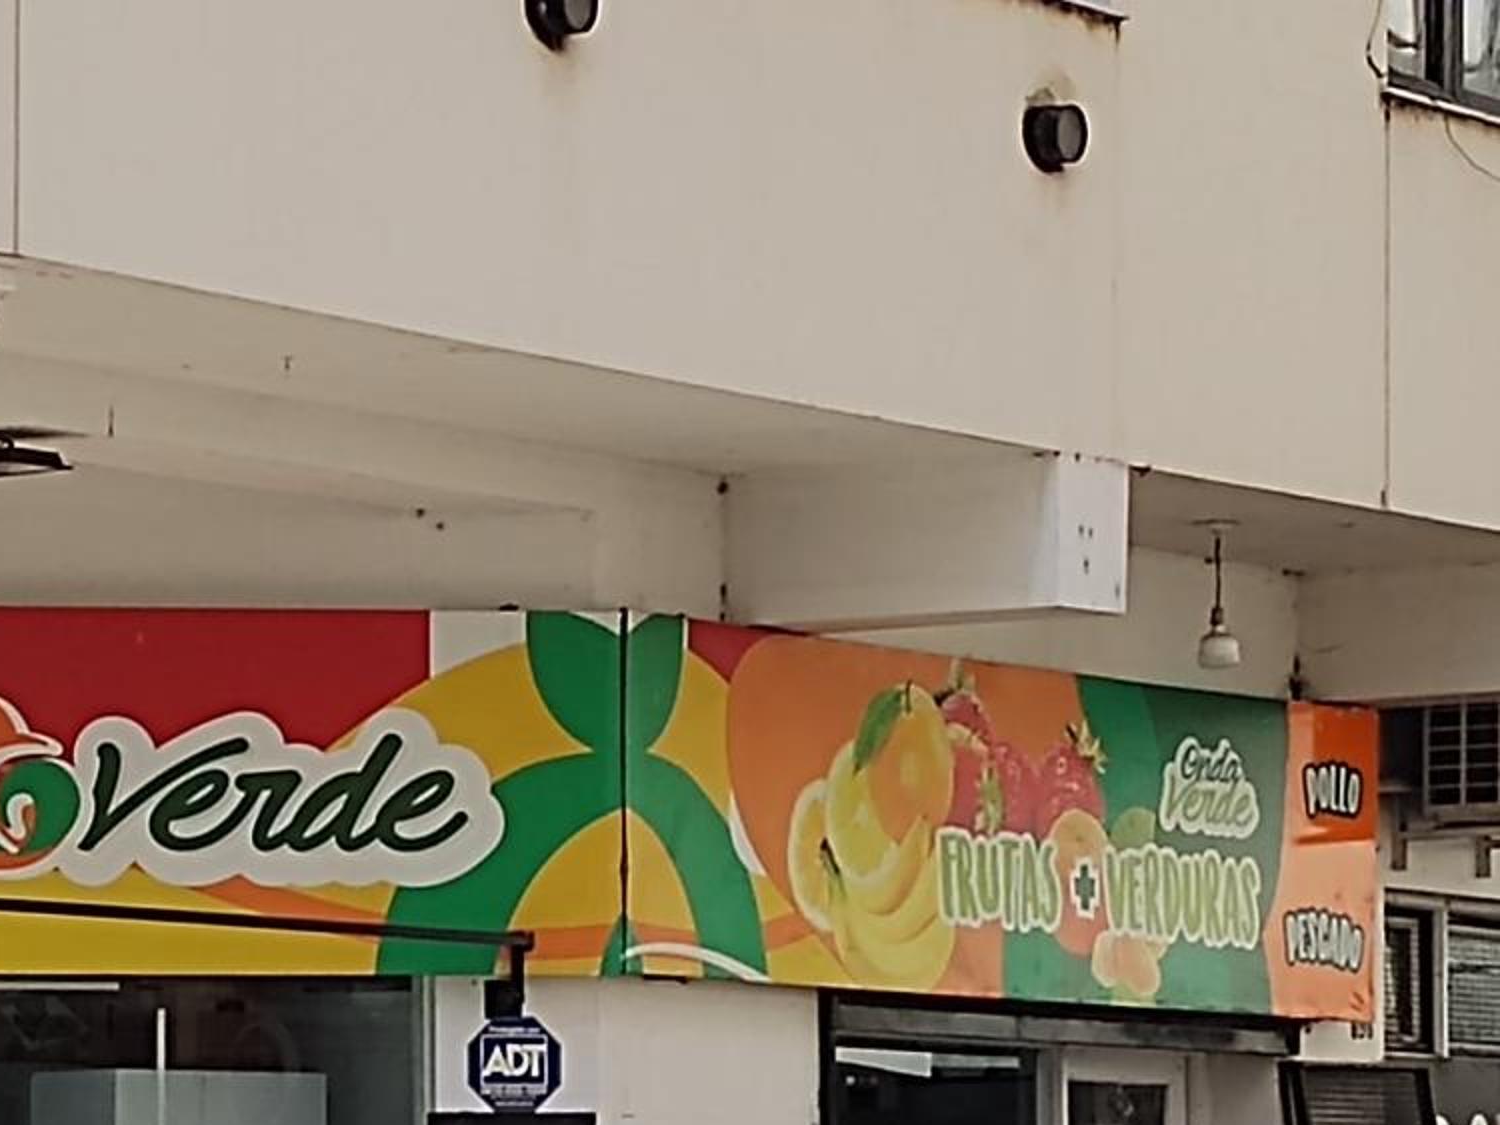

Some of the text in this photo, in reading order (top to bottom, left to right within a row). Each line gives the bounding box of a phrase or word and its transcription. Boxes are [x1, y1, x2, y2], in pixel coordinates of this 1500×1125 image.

[80, 732, 469, 854] Verde
[1305, 764, 1361, 817] POLLO
[938, 832, 1060, 930] FRUTAS
[1104, 846, 1261, 949] VERDURAS
[1285, 911, 1364, 972] PESCADO
[482, 1042, 548, 1078] ADT
